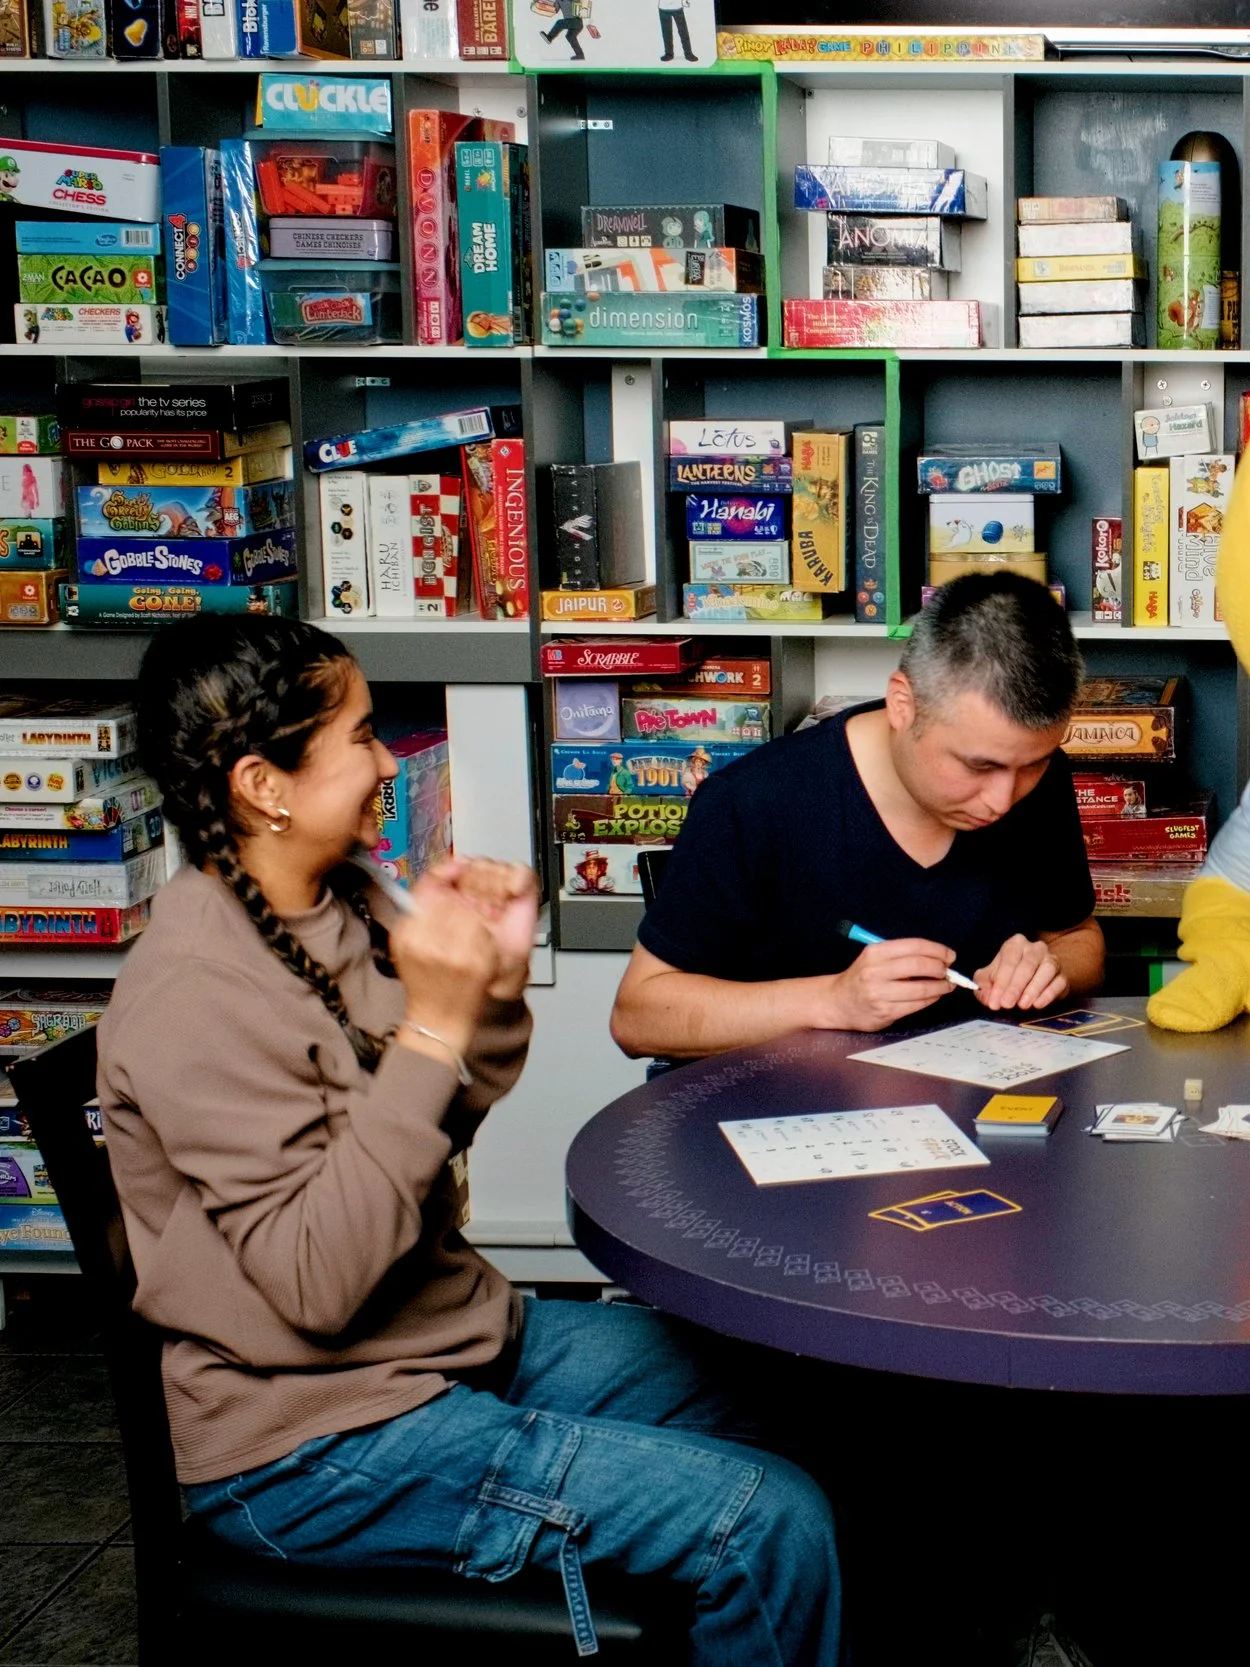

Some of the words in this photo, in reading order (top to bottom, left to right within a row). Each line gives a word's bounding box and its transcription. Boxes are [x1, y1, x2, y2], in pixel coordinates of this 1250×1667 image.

[735, 38, 773, 54] PINOY
[817, 41, 852, 53] GAME
[266, 82, 388, 114] CLUCKLE
[56, 175, 104, 191] MARIO
[64, 169, 98, 181] SUPER
[53, 188, 107, 206] CHESS
[168, 213, 188, 229] 4
[417, 170, 437, 287] DVONN
[293, 233, 324, 241] CHINESE
[326, 233, 364, 241] CHECKERS
[174, 228, 187, 281] CONNECT
[472, 222, 485, 274] DREAM
[484, 222, 497, 272] HOME
[51, 265, 126, 292] CACAO
[78, 308, 121, 316] CHECKERS
[590, 307, 699, 329] dimension
[742, 297, 752, 343] KOSMOS
[138, 397, 154, 407] the
[156, 398, 170, 407] tv
[172, 397, 206, 407] series
[120, 409, 158, 419] popularity
[160, 408, 174, 416] has
[187, 409, 207, 418] price
[1169, 421, 1203, 431] Hazard
[73, 438, 96, 447] THE
[100, 436, 124, 449] GO
[126, 438, 154, 448] PACK
[319, 440, 357, 463] CLUE
[224, 467, 233, 478] 2
[677, 463, 757, 485] LANTERNS
[866, 461, 876, 474] THE
[957, 462, 1021, 491] GHOST
[864, 476, 879, 516] KING
[224, 512, 239, 522] AEG
[700, 499, 775, 521] Hanabi
[506, 468, 525, 589] INGENIOUS
[862, 525, 879, 570] DEAD
[380, 543, 391, 590] HARU
[391, 541, 401, 592] ICHIBAN
[799, 530, 833, 587] KARUBA
[129, 596, 202, 611] GONE!
[427, 603, 438, 611] 2
[555, 598, 606, 615] JAIPUR
[1147, 591, 1158, 618] HABA
[577, 650, 641, 670] SCRABBLE
[752, 676, 762, 686] 2
[560, 704, 614, 721] Onitama
[634, 710, 667, 733] Pie
[21, 733, 91, 745] LABYRINTH
[636, 768, 681, 788] 1901
[593, 819, 683, 838] EXPLOS
[1165, 825, 1199, 833] SLUGFEST
[1096, 884, 1131, 903] isk
[0, 911, 98, 935] BYRINTH
[31, 1011, 86, 1037] SAGRADA
[32, 1208, 55, 1216] Disney
